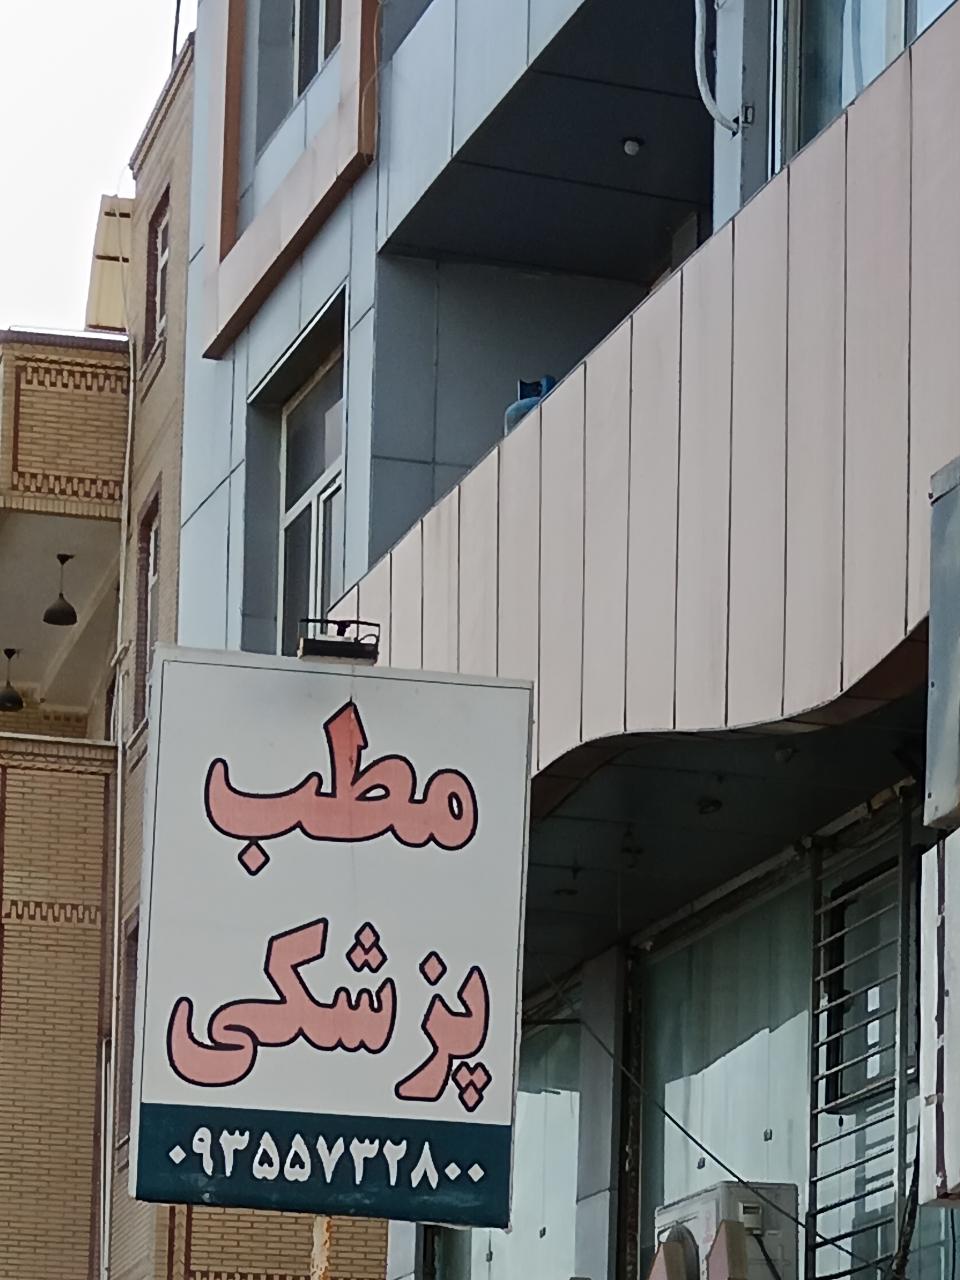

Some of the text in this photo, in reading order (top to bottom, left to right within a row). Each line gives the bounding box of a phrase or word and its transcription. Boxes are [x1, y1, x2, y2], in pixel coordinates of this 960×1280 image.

[203, 701, 479, 876] مطب
[166, 917, 493, 1112] پزشکی
[167, 1125, 486, 1191] ۰۹۳۵۵۷۳۲۸۰۰
